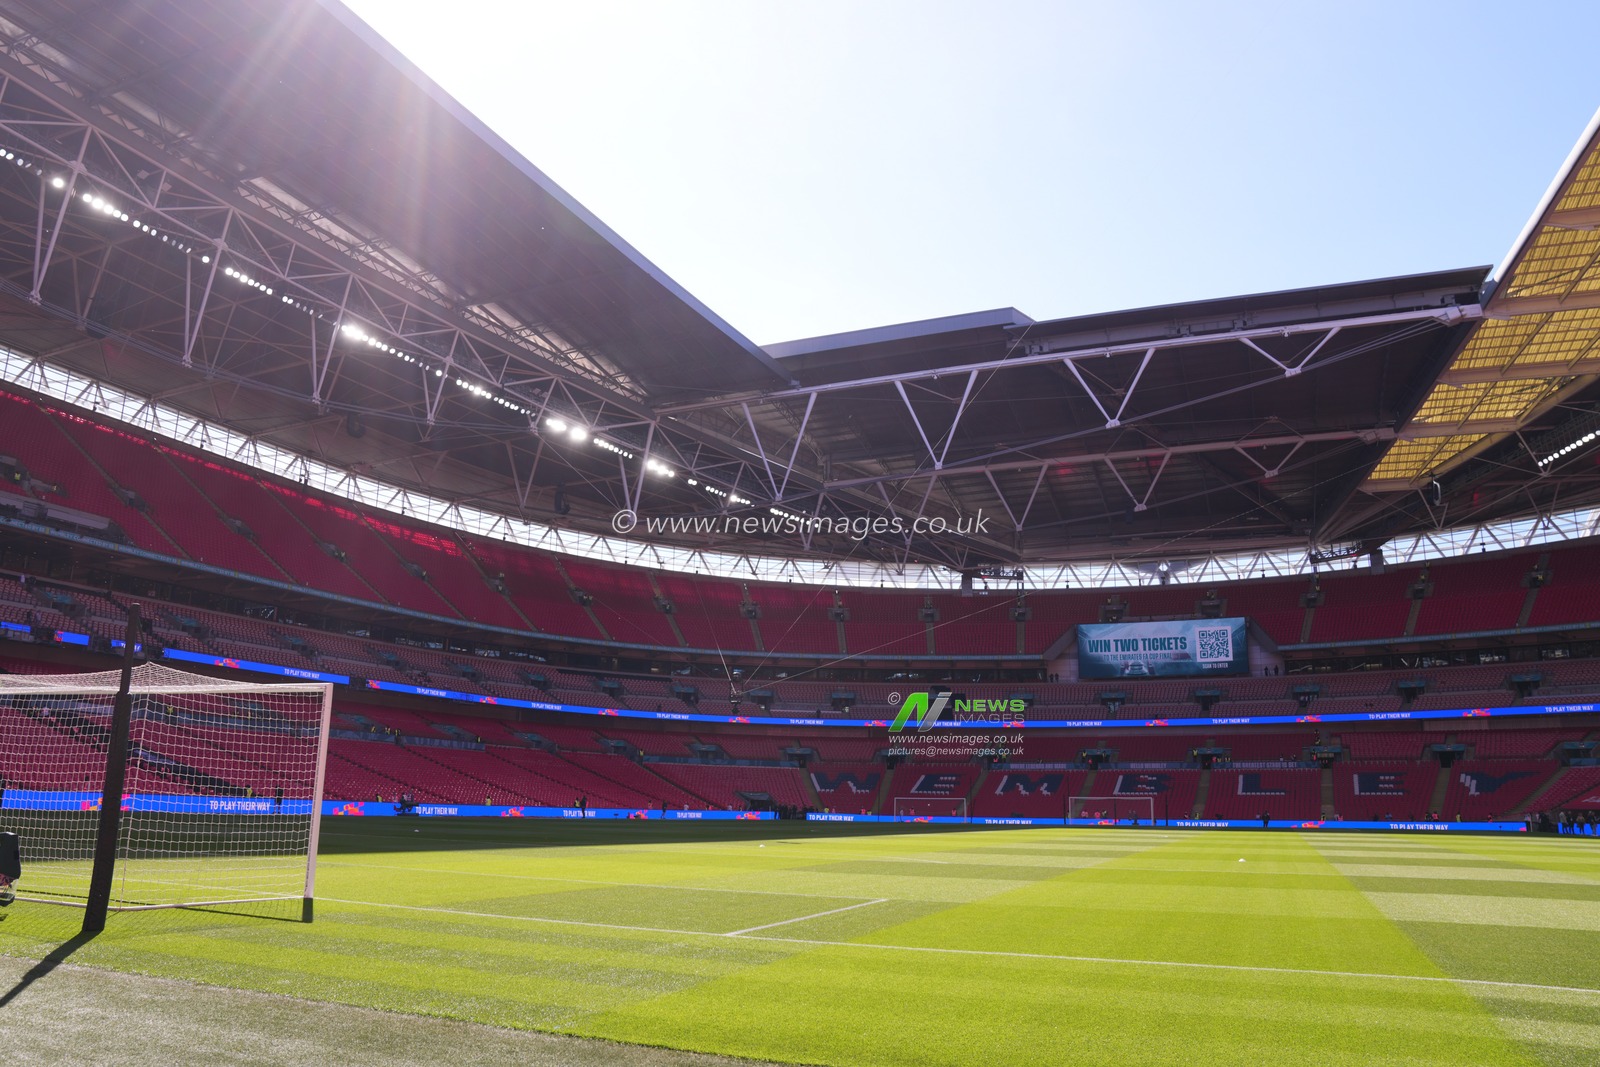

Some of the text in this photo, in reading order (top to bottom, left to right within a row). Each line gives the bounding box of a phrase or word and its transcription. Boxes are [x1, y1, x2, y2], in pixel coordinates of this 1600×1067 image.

[1088, 636, 1188, 652] WIN TWO TICKETS
[210, 800, 270, 811] TO PLAY THEIR WAY
